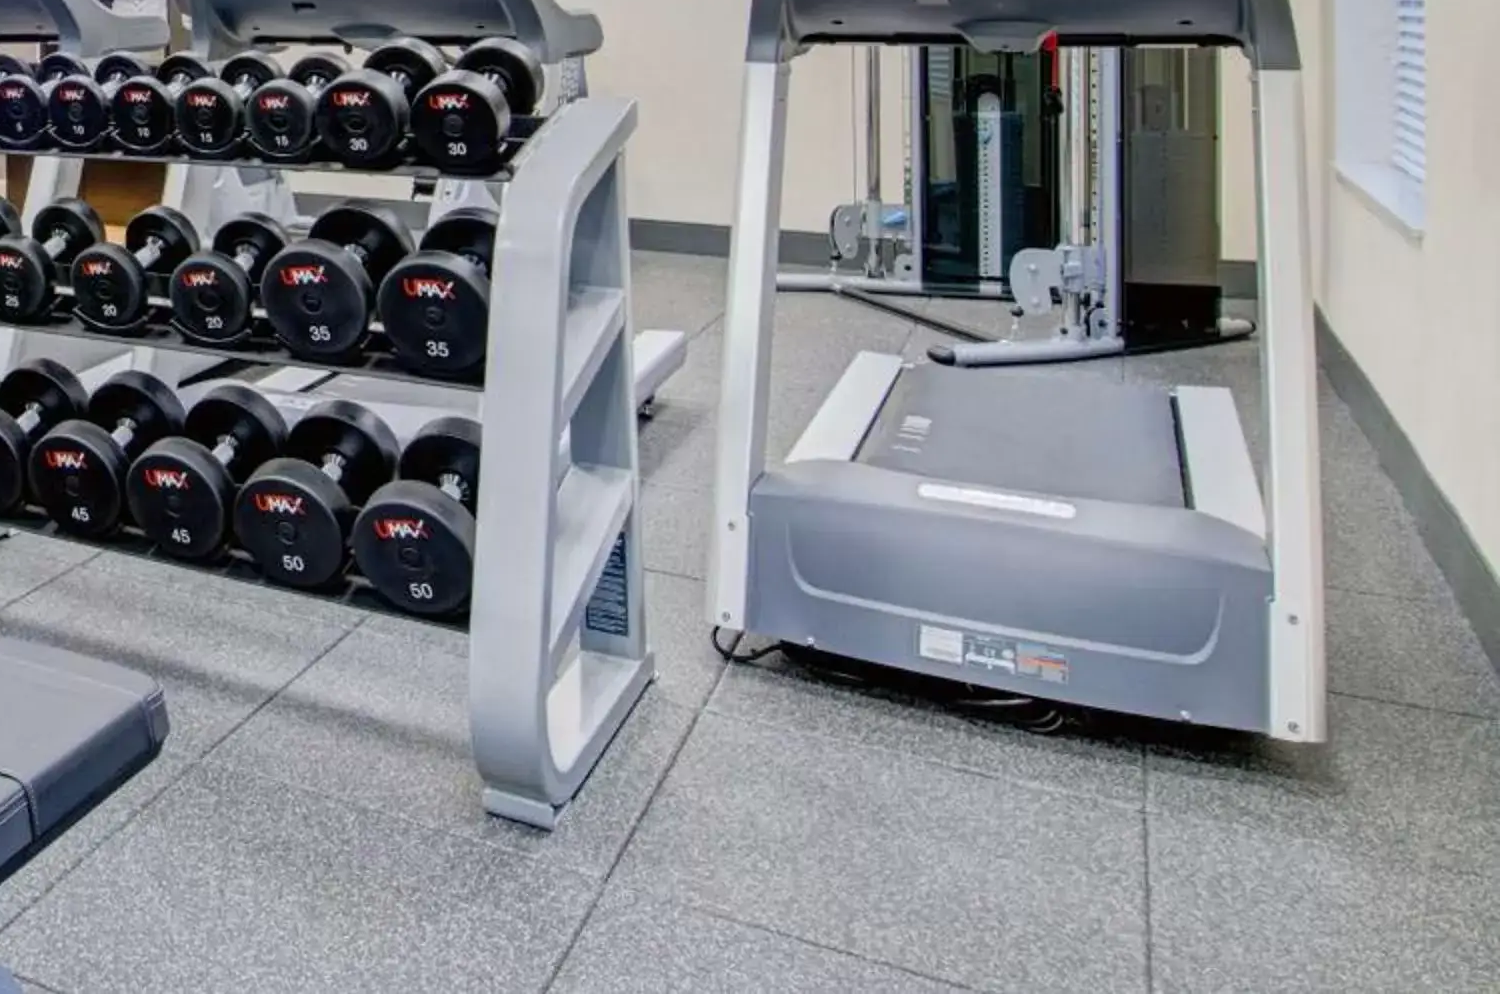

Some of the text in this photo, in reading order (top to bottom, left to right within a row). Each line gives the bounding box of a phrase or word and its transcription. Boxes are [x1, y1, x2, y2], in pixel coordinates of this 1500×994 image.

[72, 125, 85, 136] 10
[137, 127, 151, 138] 10
[199, 131, 213, 144] 15
[350, 137, 368, 151] 30
[448, 143, 467, 155] 30
[84, 261, 112, 275] UMAX
[281, 266, 328, 285] UMAX
[182, 271, 218, 286] UMAX
[404, 278, 455, 299] UMAX
[102, 304, 117, 317] 20
[205, 316, 223, 329] 20
[309, 325, 331, 341] 35
[426, 341, 449, 357] 35
[47, 450, 87, 469] UMAX
[145, 469, 190, 490] UMAX
[256, 494, 305, 515] UMAX
[71, 507, 90, 522] 45
[171, 529, 191, 544] 45
[373, 519, 429, 540] UMAX
[284, 555, 304, 571] 50
[411, 583, 433, 599] 50
